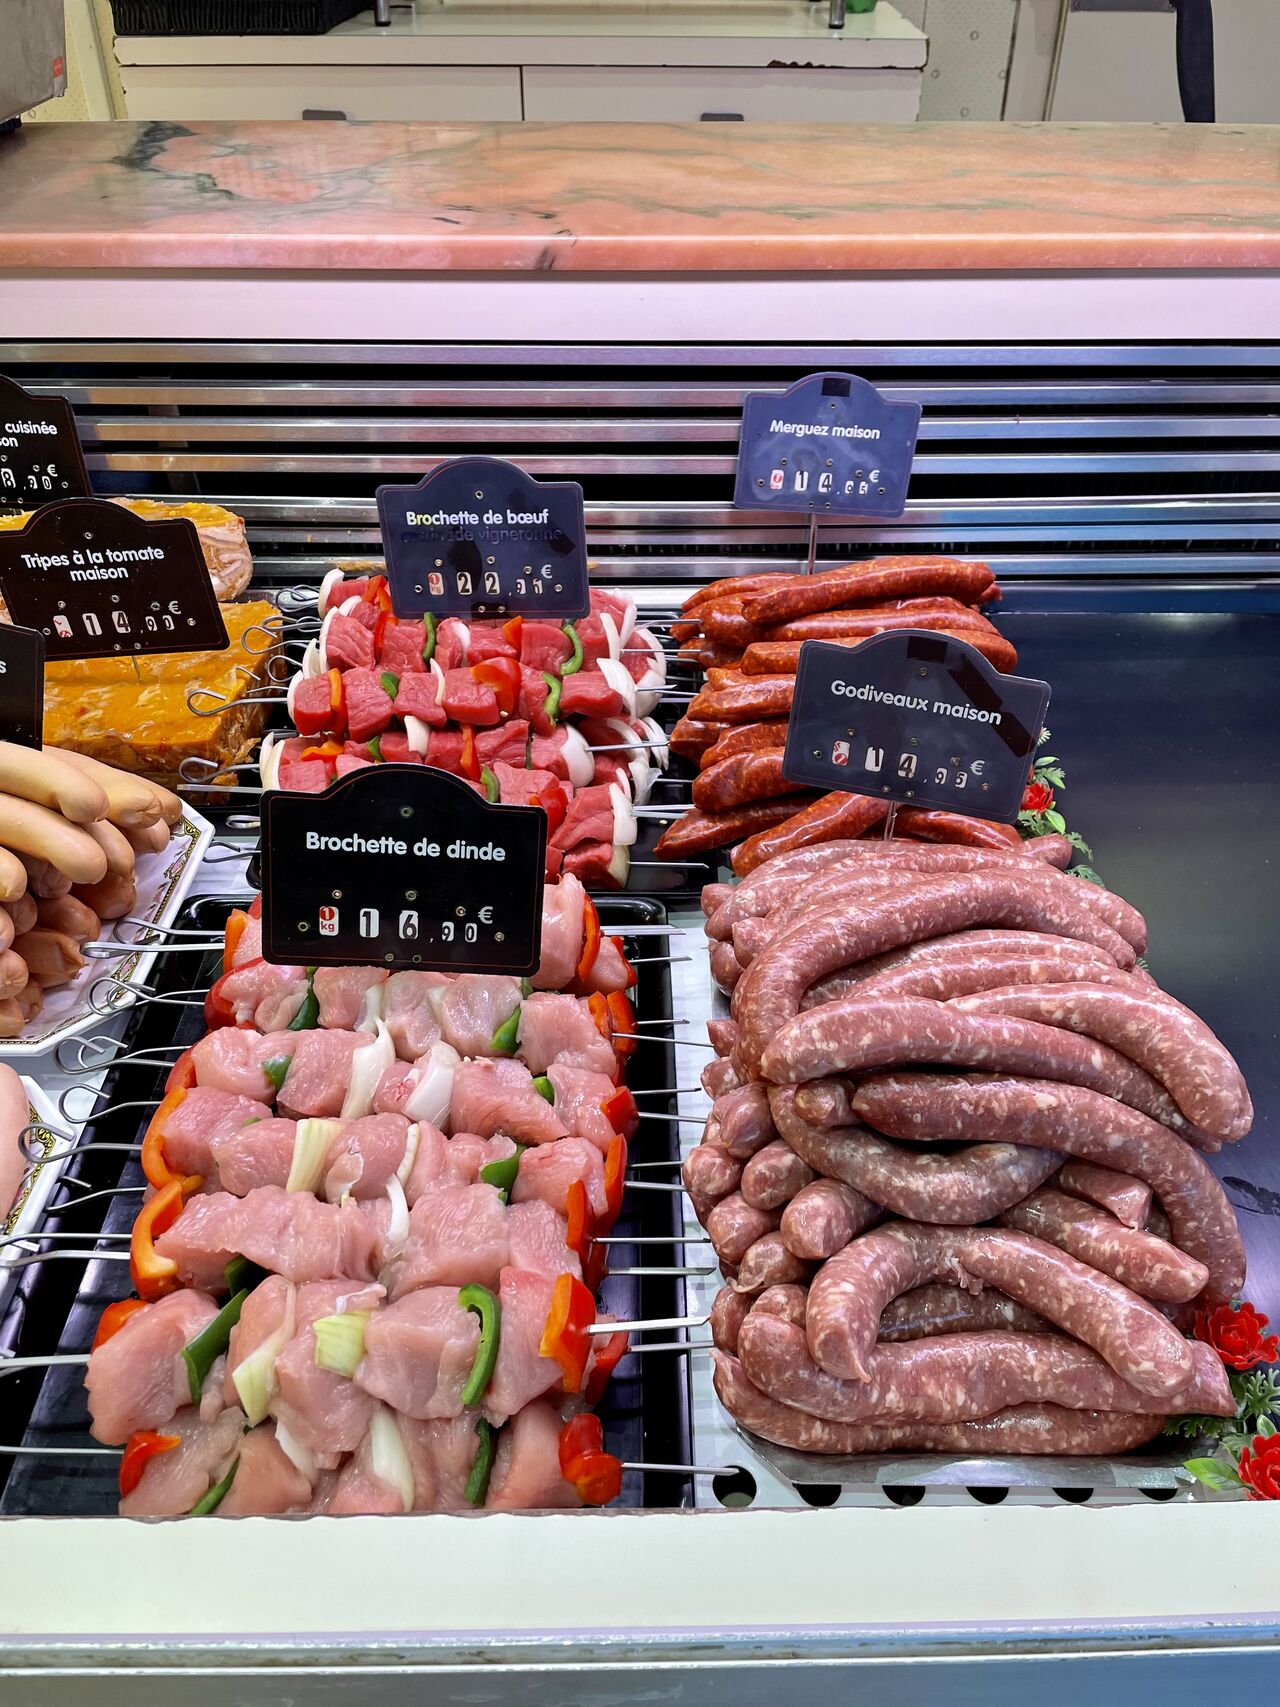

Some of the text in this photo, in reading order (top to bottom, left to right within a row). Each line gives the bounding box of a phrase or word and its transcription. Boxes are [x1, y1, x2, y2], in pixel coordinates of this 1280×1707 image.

[4, 420, 58, 435] cuisinée
[769, 419, 881, 440] Merguez maison
[406, 508, 549, 526] Brochette de bœuf
[20, 546, 165, 572] Tripes à la tomate
[69, 565, 129, 582] maison
[830, 680, 1002, 725] Godiveaux maison
[306, 831, 506, 862] Brochette de dinde
